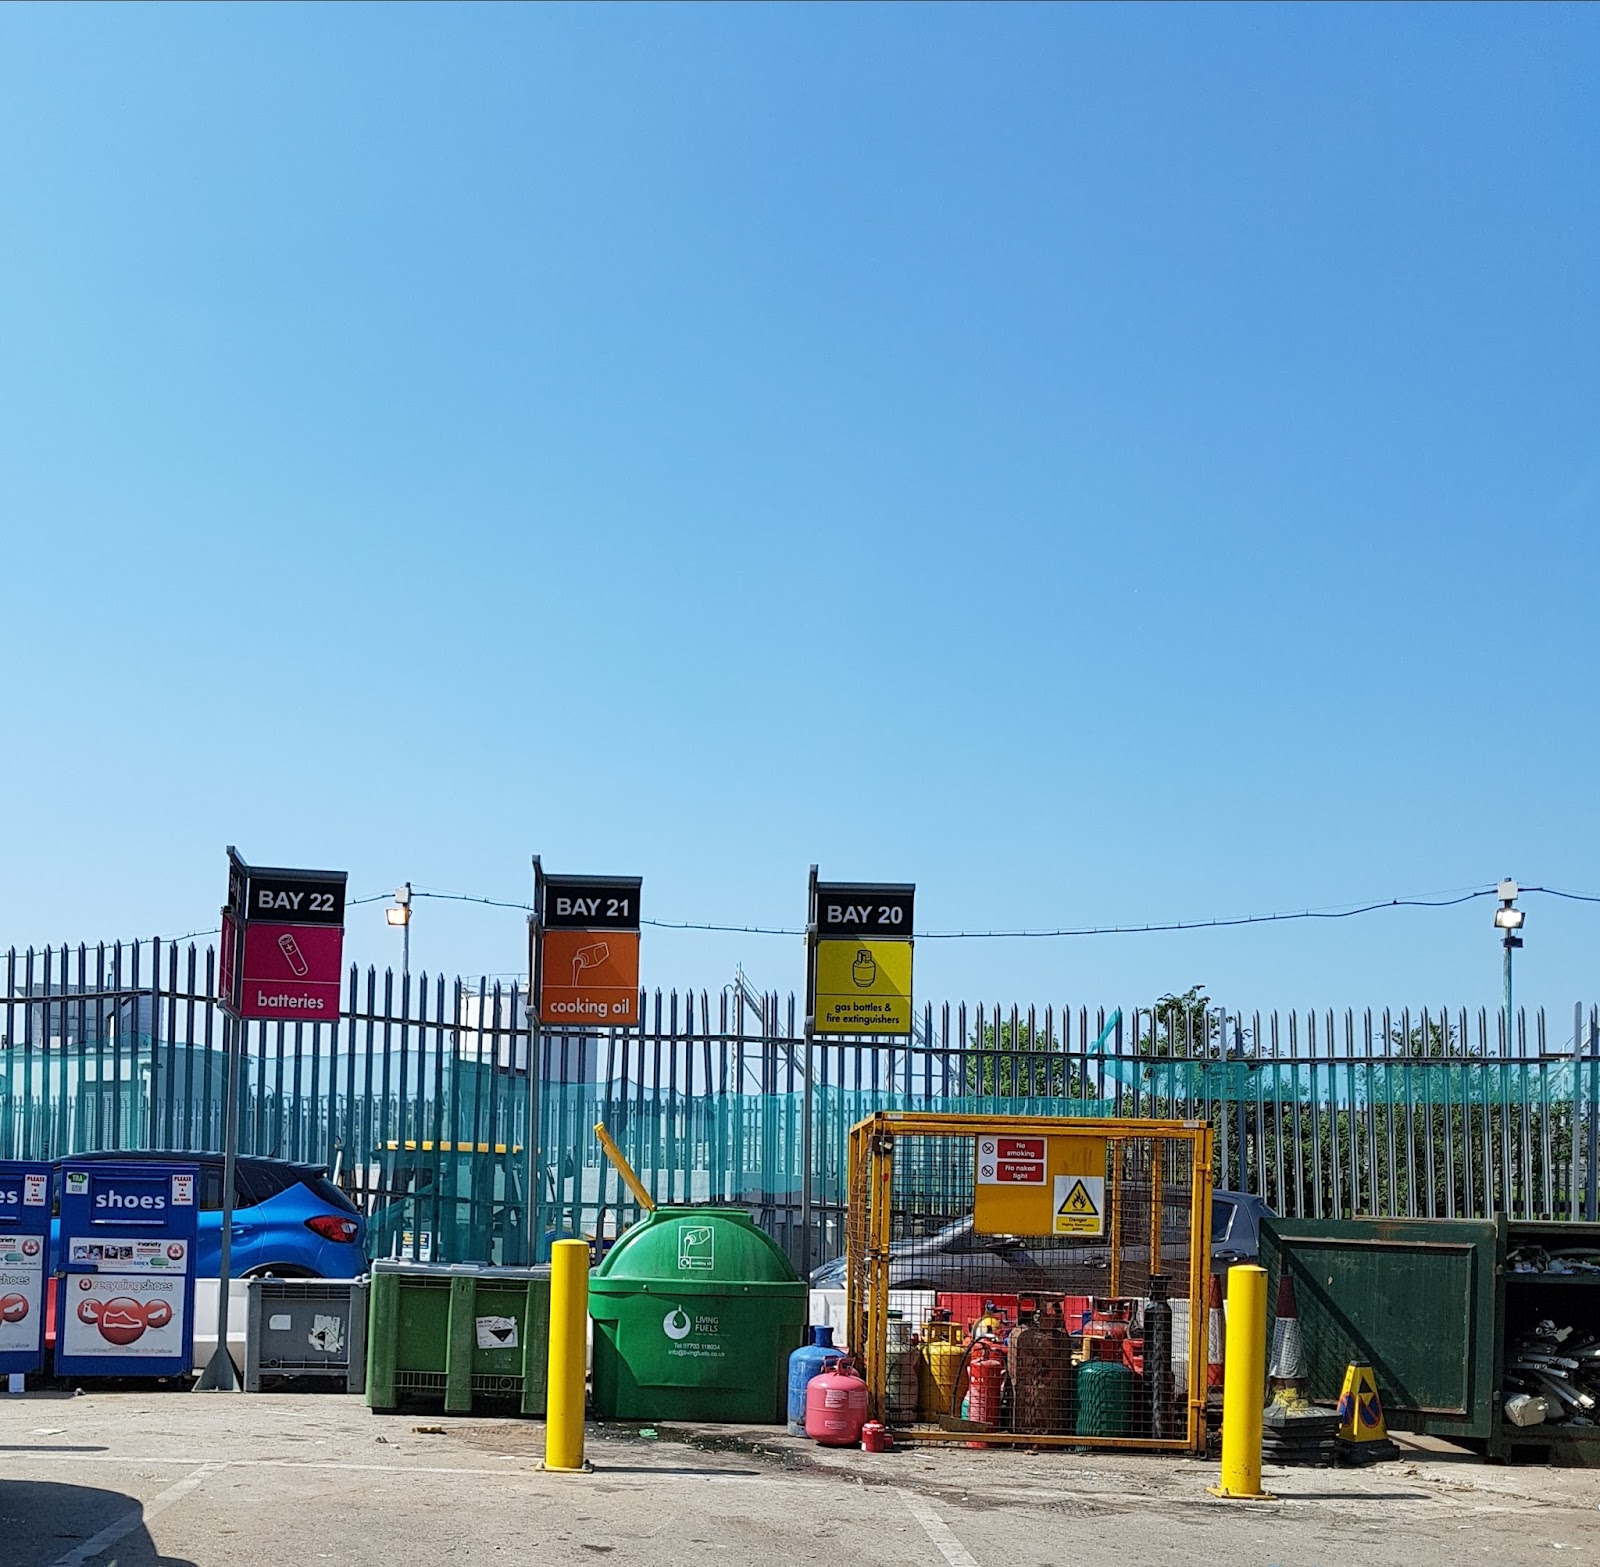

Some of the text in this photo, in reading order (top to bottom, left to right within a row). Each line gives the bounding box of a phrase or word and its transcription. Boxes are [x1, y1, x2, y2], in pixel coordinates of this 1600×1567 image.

[258, 890, 335, 911] BAY 22
[556, 898, 629, 917] BAY 21
[827, 905, 903, 924] BAY 20
[257, 990, 324, 1009] batteries
[550, 997, 630, 1017] cooking oil
[834, 1001, 892, 1013] gas bottles &
[826, 1012, 900, 1026] fire extinguishers
[1006, 1150, 1035, 1158] smoking
[1012, 1172, 1028, 1180] light
[95, 1190, 165, 1209] shoes
[695, 1316, 719, 1324] LIVING
[695, 1324, 718, 1332] FUELS
